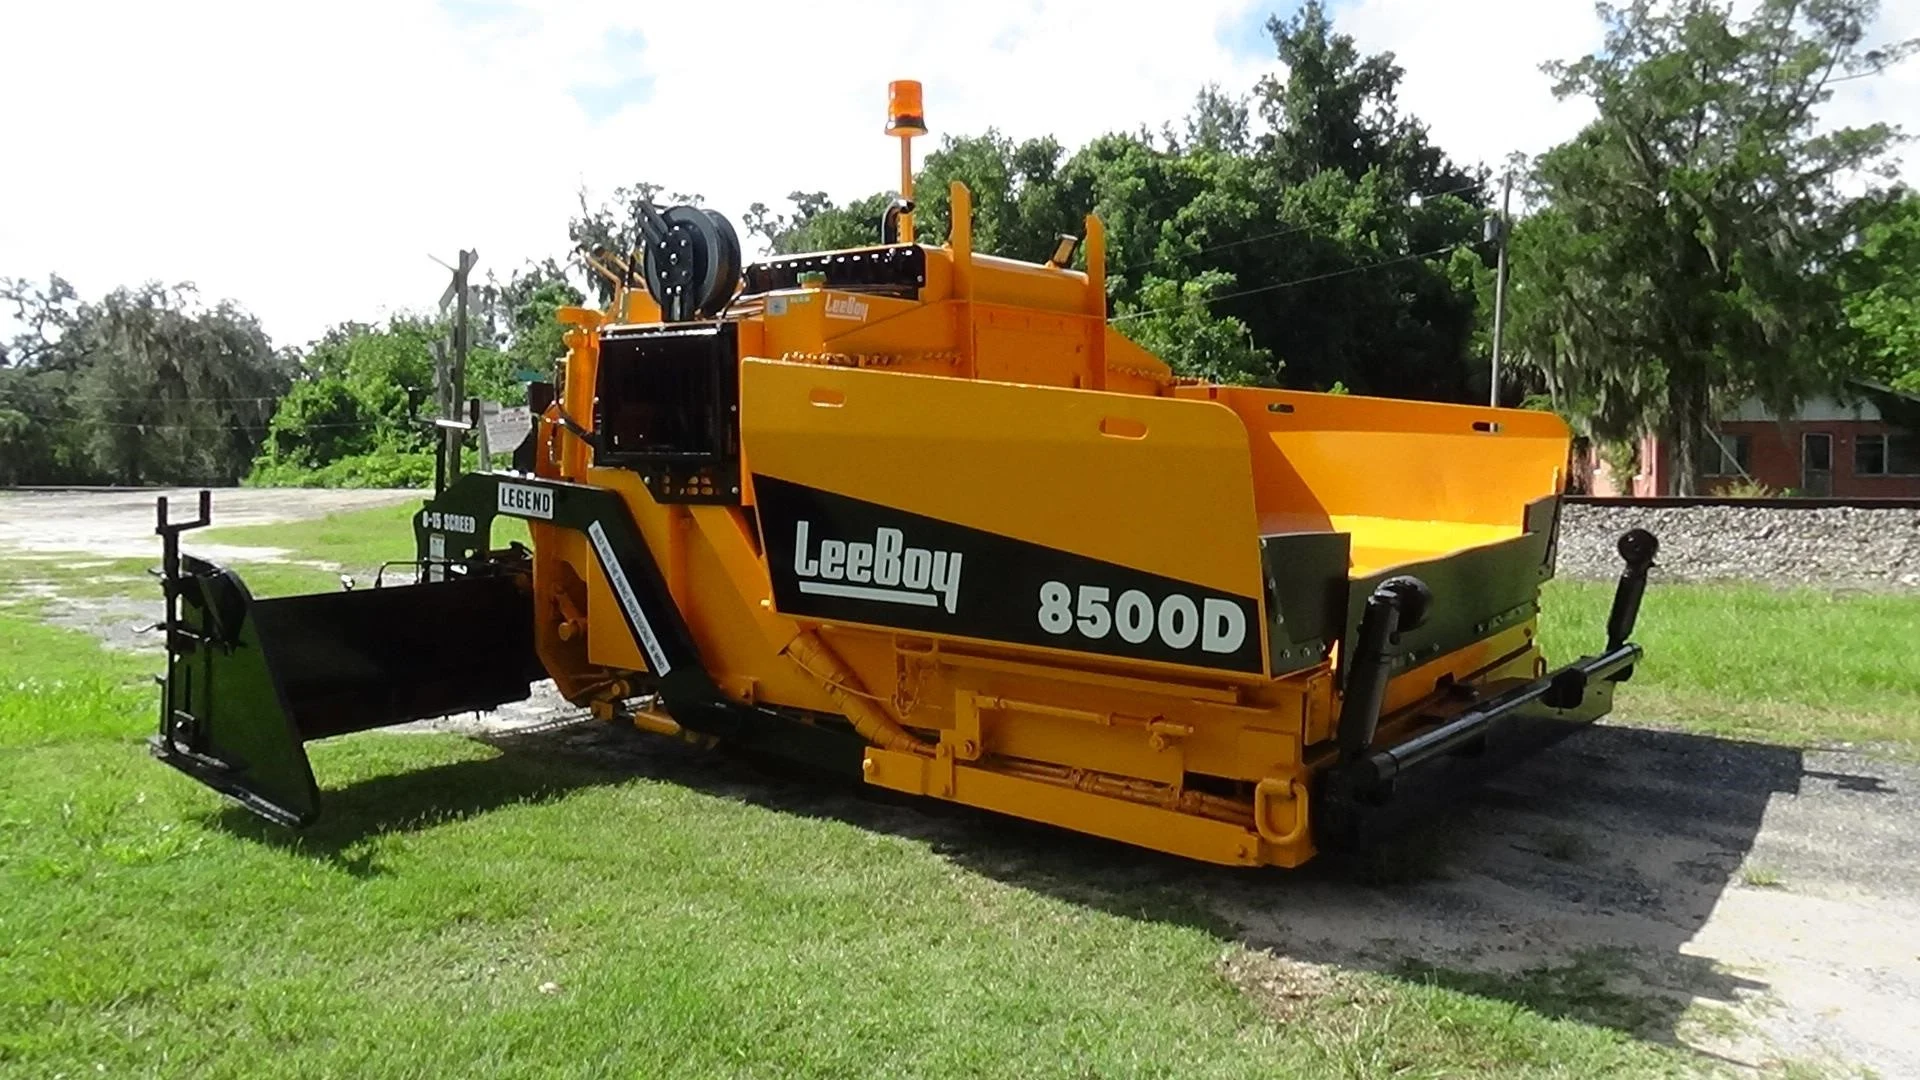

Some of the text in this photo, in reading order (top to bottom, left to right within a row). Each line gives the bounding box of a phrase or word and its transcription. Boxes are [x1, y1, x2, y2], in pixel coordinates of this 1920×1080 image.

[825, 293, 869, 323] LeeBoy
[501, 488, 550, 513] LEGEND
[443, 513, 476, 534] SCREED
[794, 520, 963, 614] LeeBoy
[1038, 580, 1247, 654] 8500D
